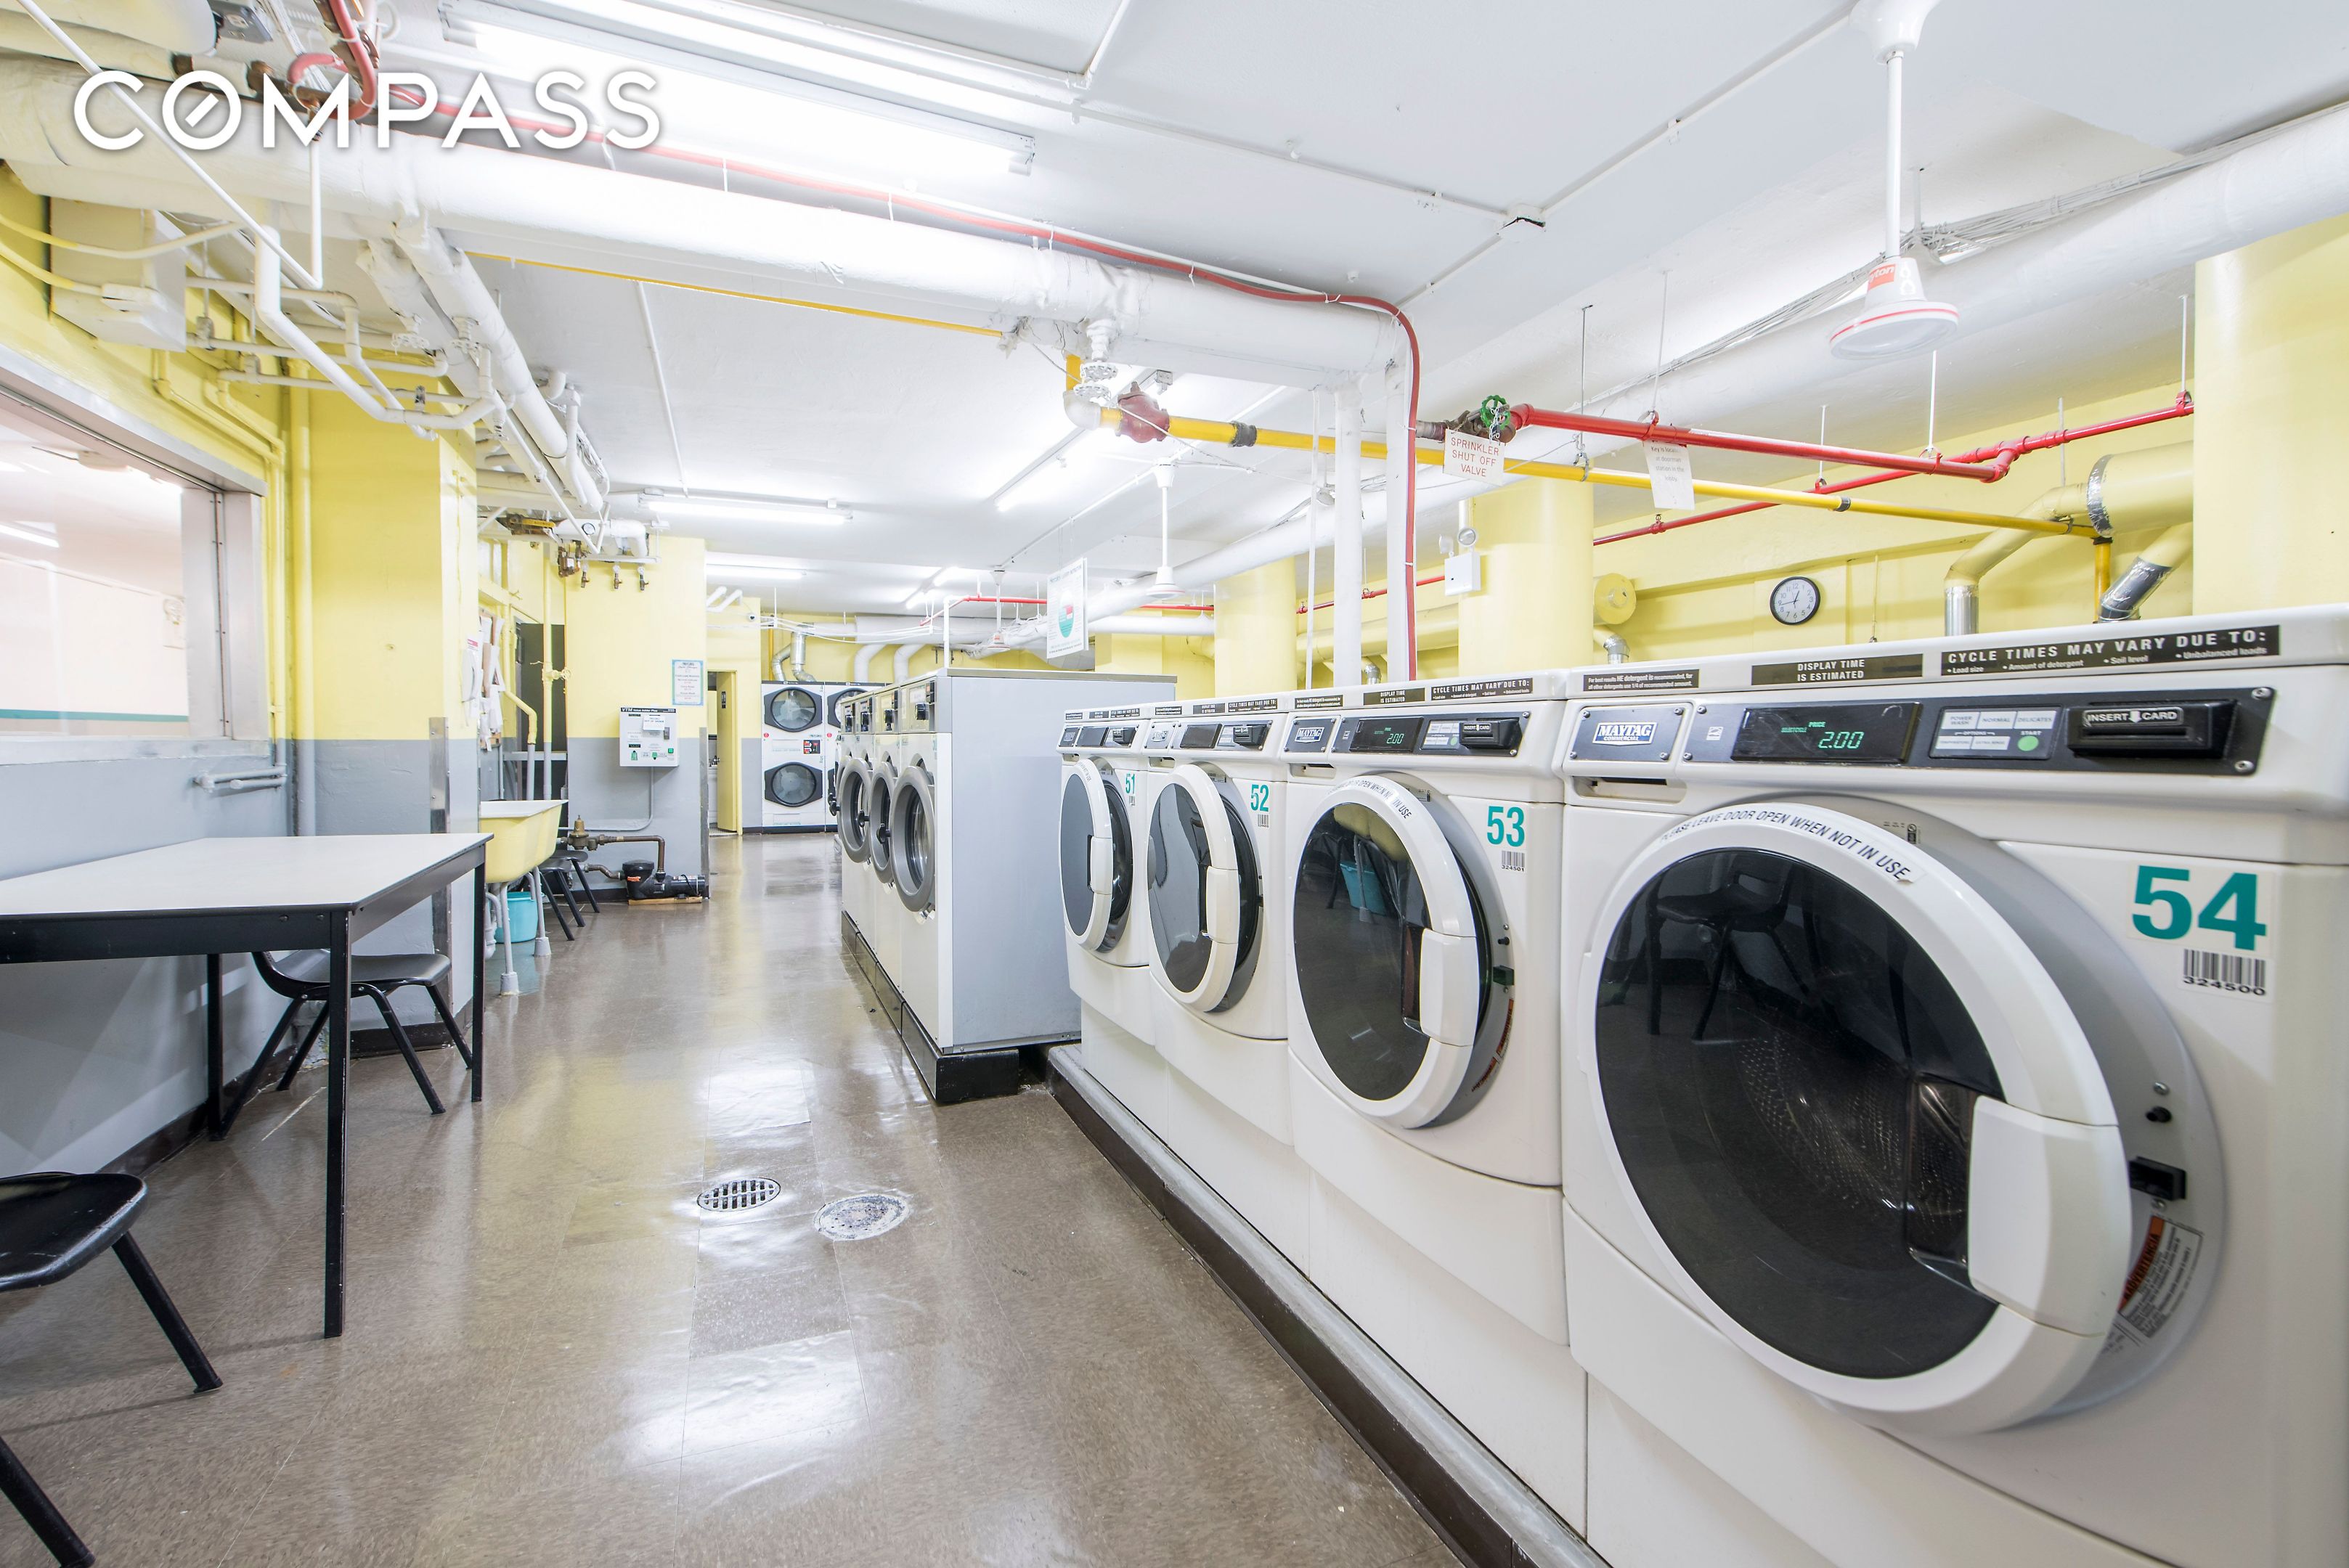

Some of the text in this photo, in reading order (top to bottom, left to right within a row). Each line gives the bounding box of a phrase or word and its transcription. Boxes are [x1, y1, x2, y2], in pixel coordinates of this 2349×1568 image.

[1451, 437, 1499, 456] SPRINKLER
[1452, 450, 1497, 467] SHUT OFF
[1461, 463, 1487, 477] VALVE
[1948, 629, 2266, 663] CYCLE TIMES MAY VARY DUE TO:
[2183, 648, 2238, 660] Unbalanced
[1797, 659, 1865, 671] DISPLAY TIME
[2047, 660, 2084, 669] detergent
[1810, 670, 1865, 681] ESTIMATED
[2086, 711, 2178, 722] INSERT CARD
[1298, 728, 1322, 737] MAYTAG
[1386, 733, 1404, 744] 2.00
[1597, 724, 1651, 737] MAYTAG
[1817, 731, 1865, 749] 2.00
[1125, 773, 1136, 794] 51
[1250, 784, 1269, 812] 52
[1398, 804, 1412, 819] USE
[1486, 805, 1525, 847] 53
[1723, 810, 1756, 820] DOOR
[1756, 810, 1789, 825] OPEN
[1789, 815, 1833, 836] WHEN
[1828, 828, 1860, 849] NOT
[1857, 844, 1878, 859] IN
[1876, 855, 1911, 880] USE
[2133, 865, 2267, 951] 54
[2183, 976, 2266, 997] 324500
